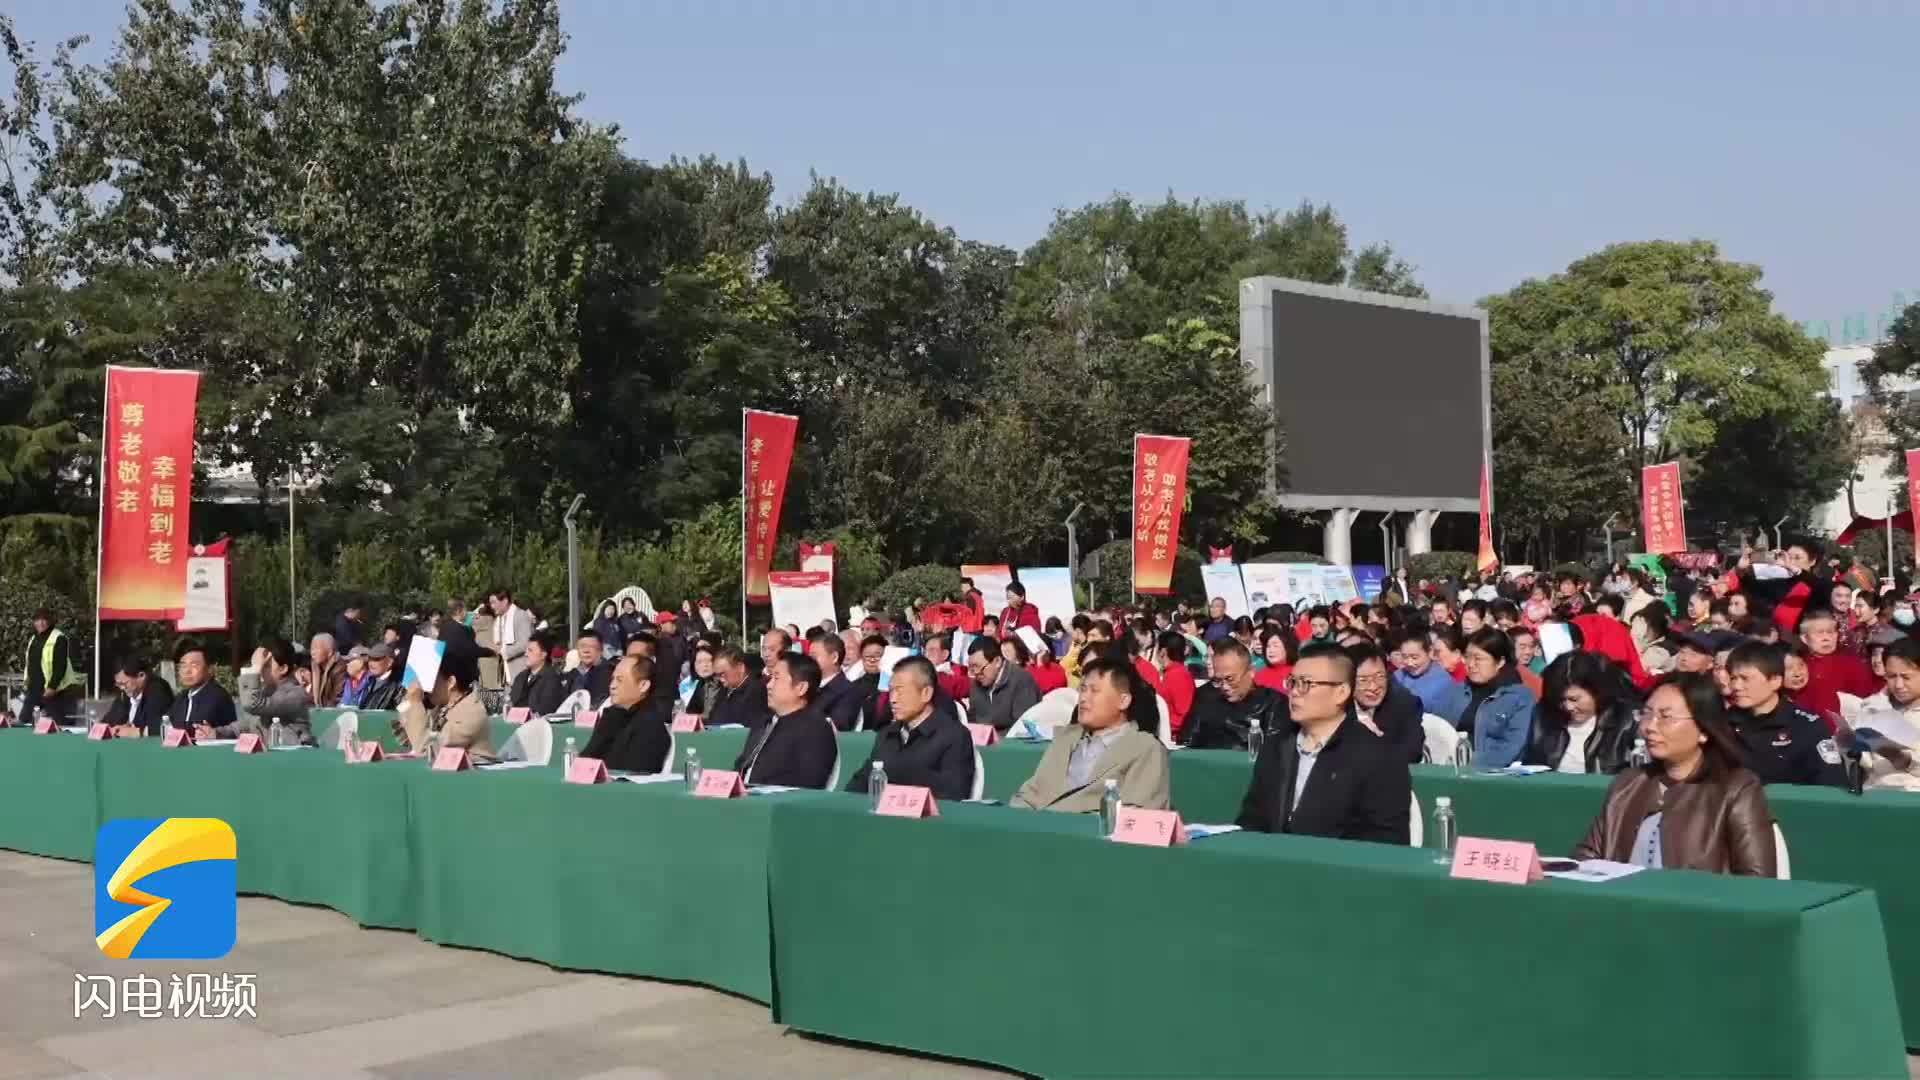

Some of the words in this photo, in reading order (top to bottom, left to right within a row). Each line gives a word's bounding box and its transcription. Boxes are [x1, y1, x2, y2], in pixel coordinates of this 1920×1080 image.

[115, 402, 145, 513] 尊老敬老
[148, 455, 177, 565] 幸福到老
[1464, 850, 1521, 872] 王晓红
